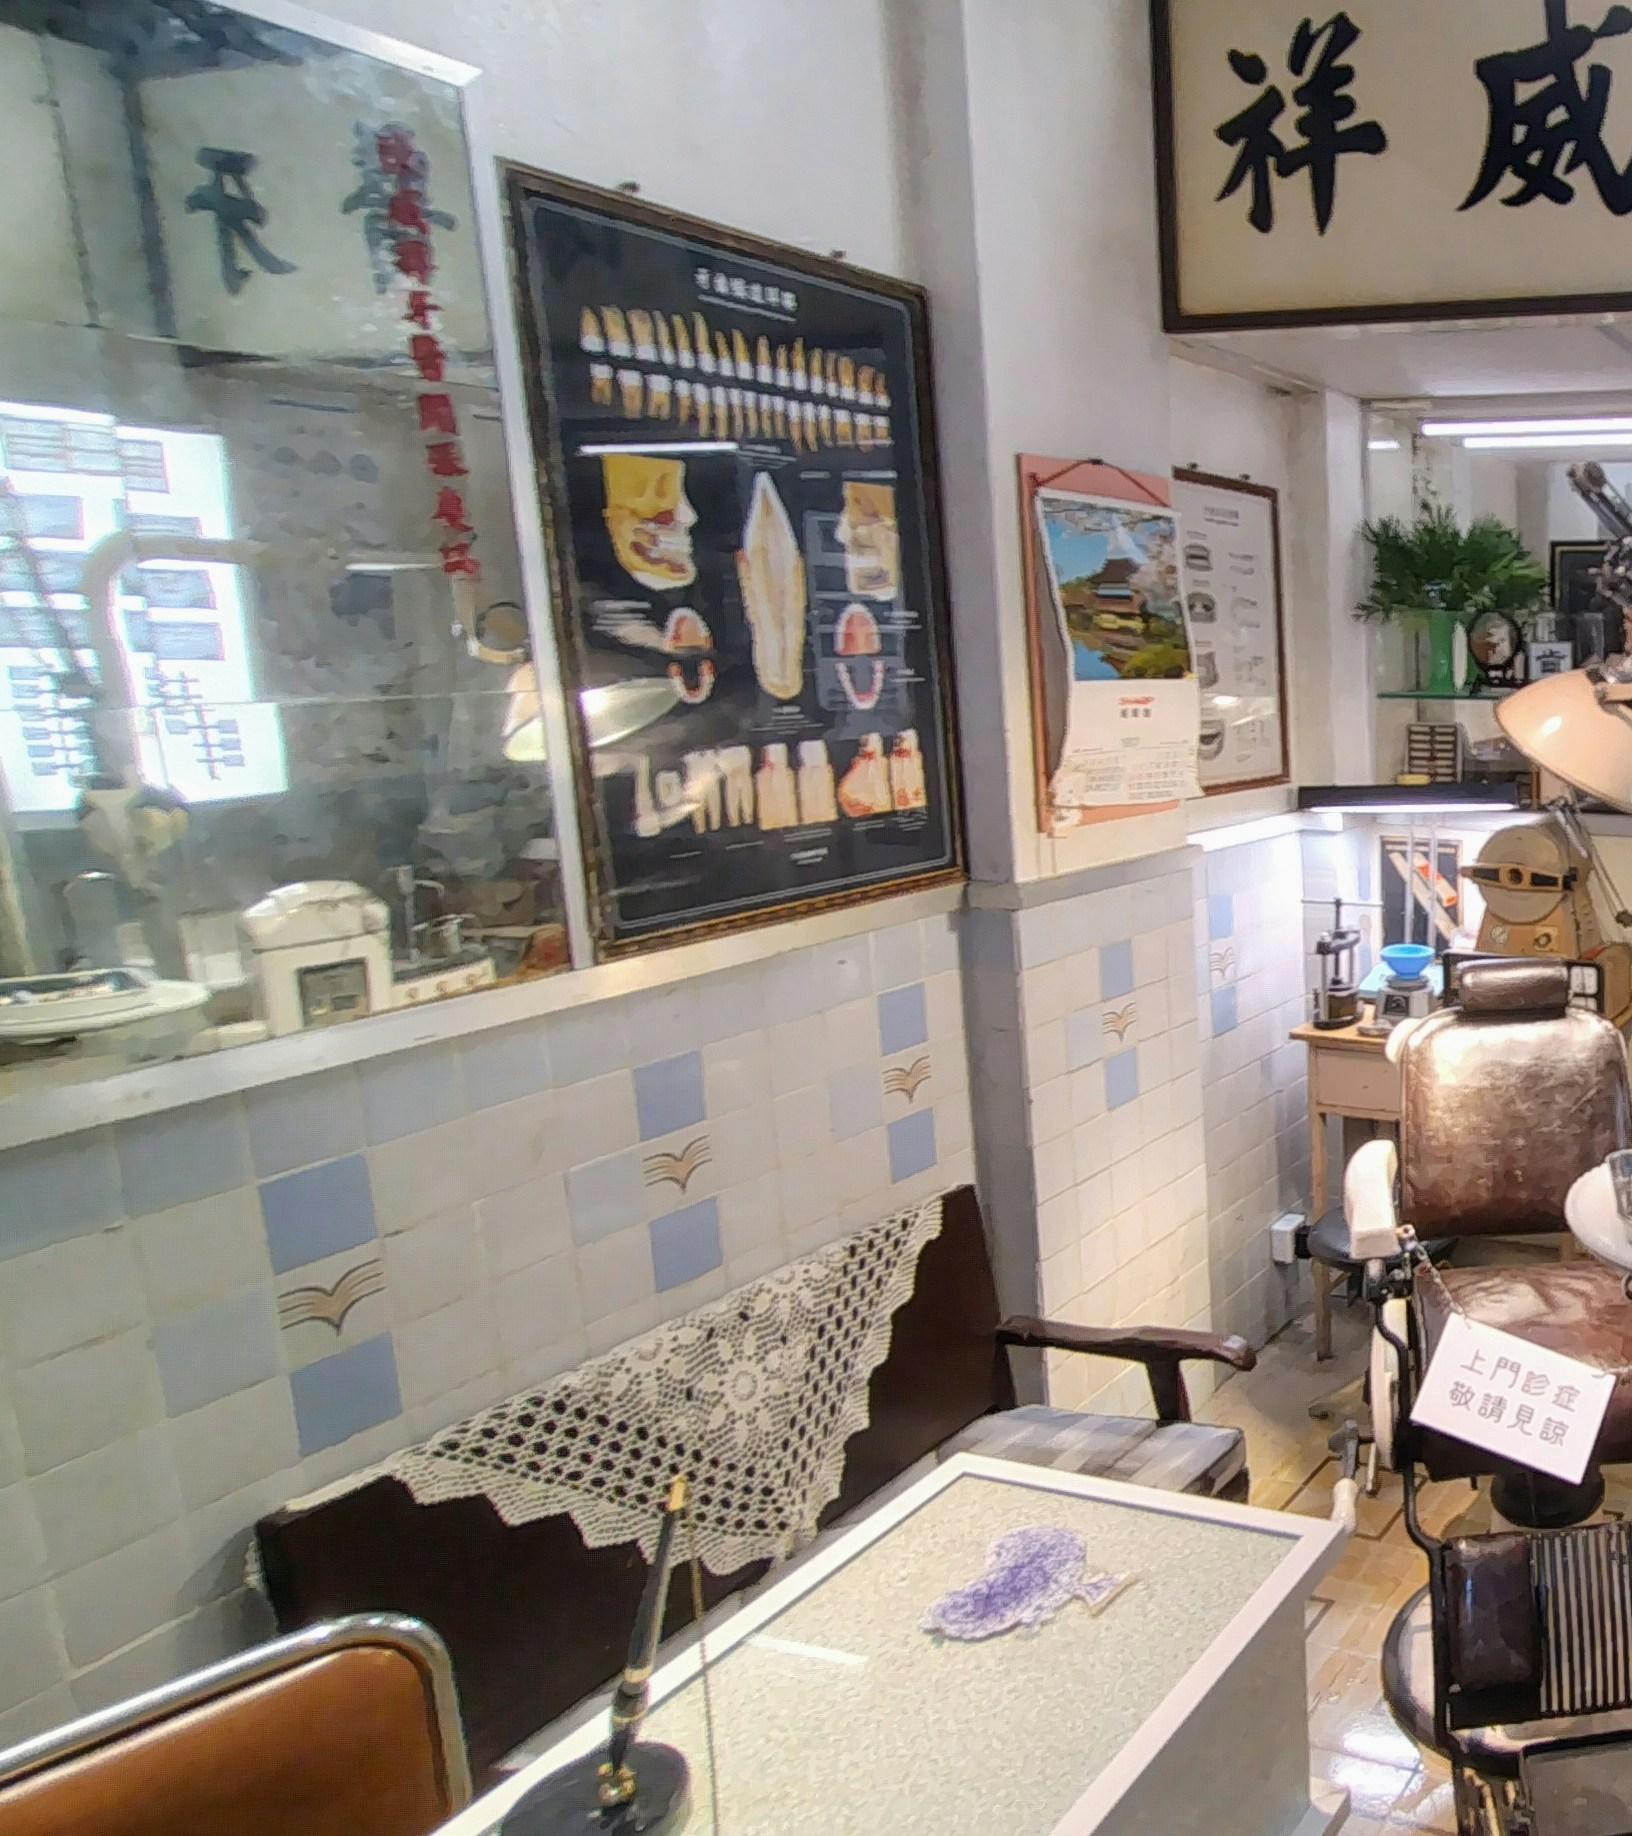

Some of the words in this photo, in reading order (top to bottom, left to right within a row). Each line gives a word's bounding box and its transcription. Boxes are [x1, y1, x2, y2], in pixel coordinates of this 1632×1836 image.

[1448, 1380, 1571, 1447] 敬請見諒
[1460, 1348, 1582, 1413] 上門診症
